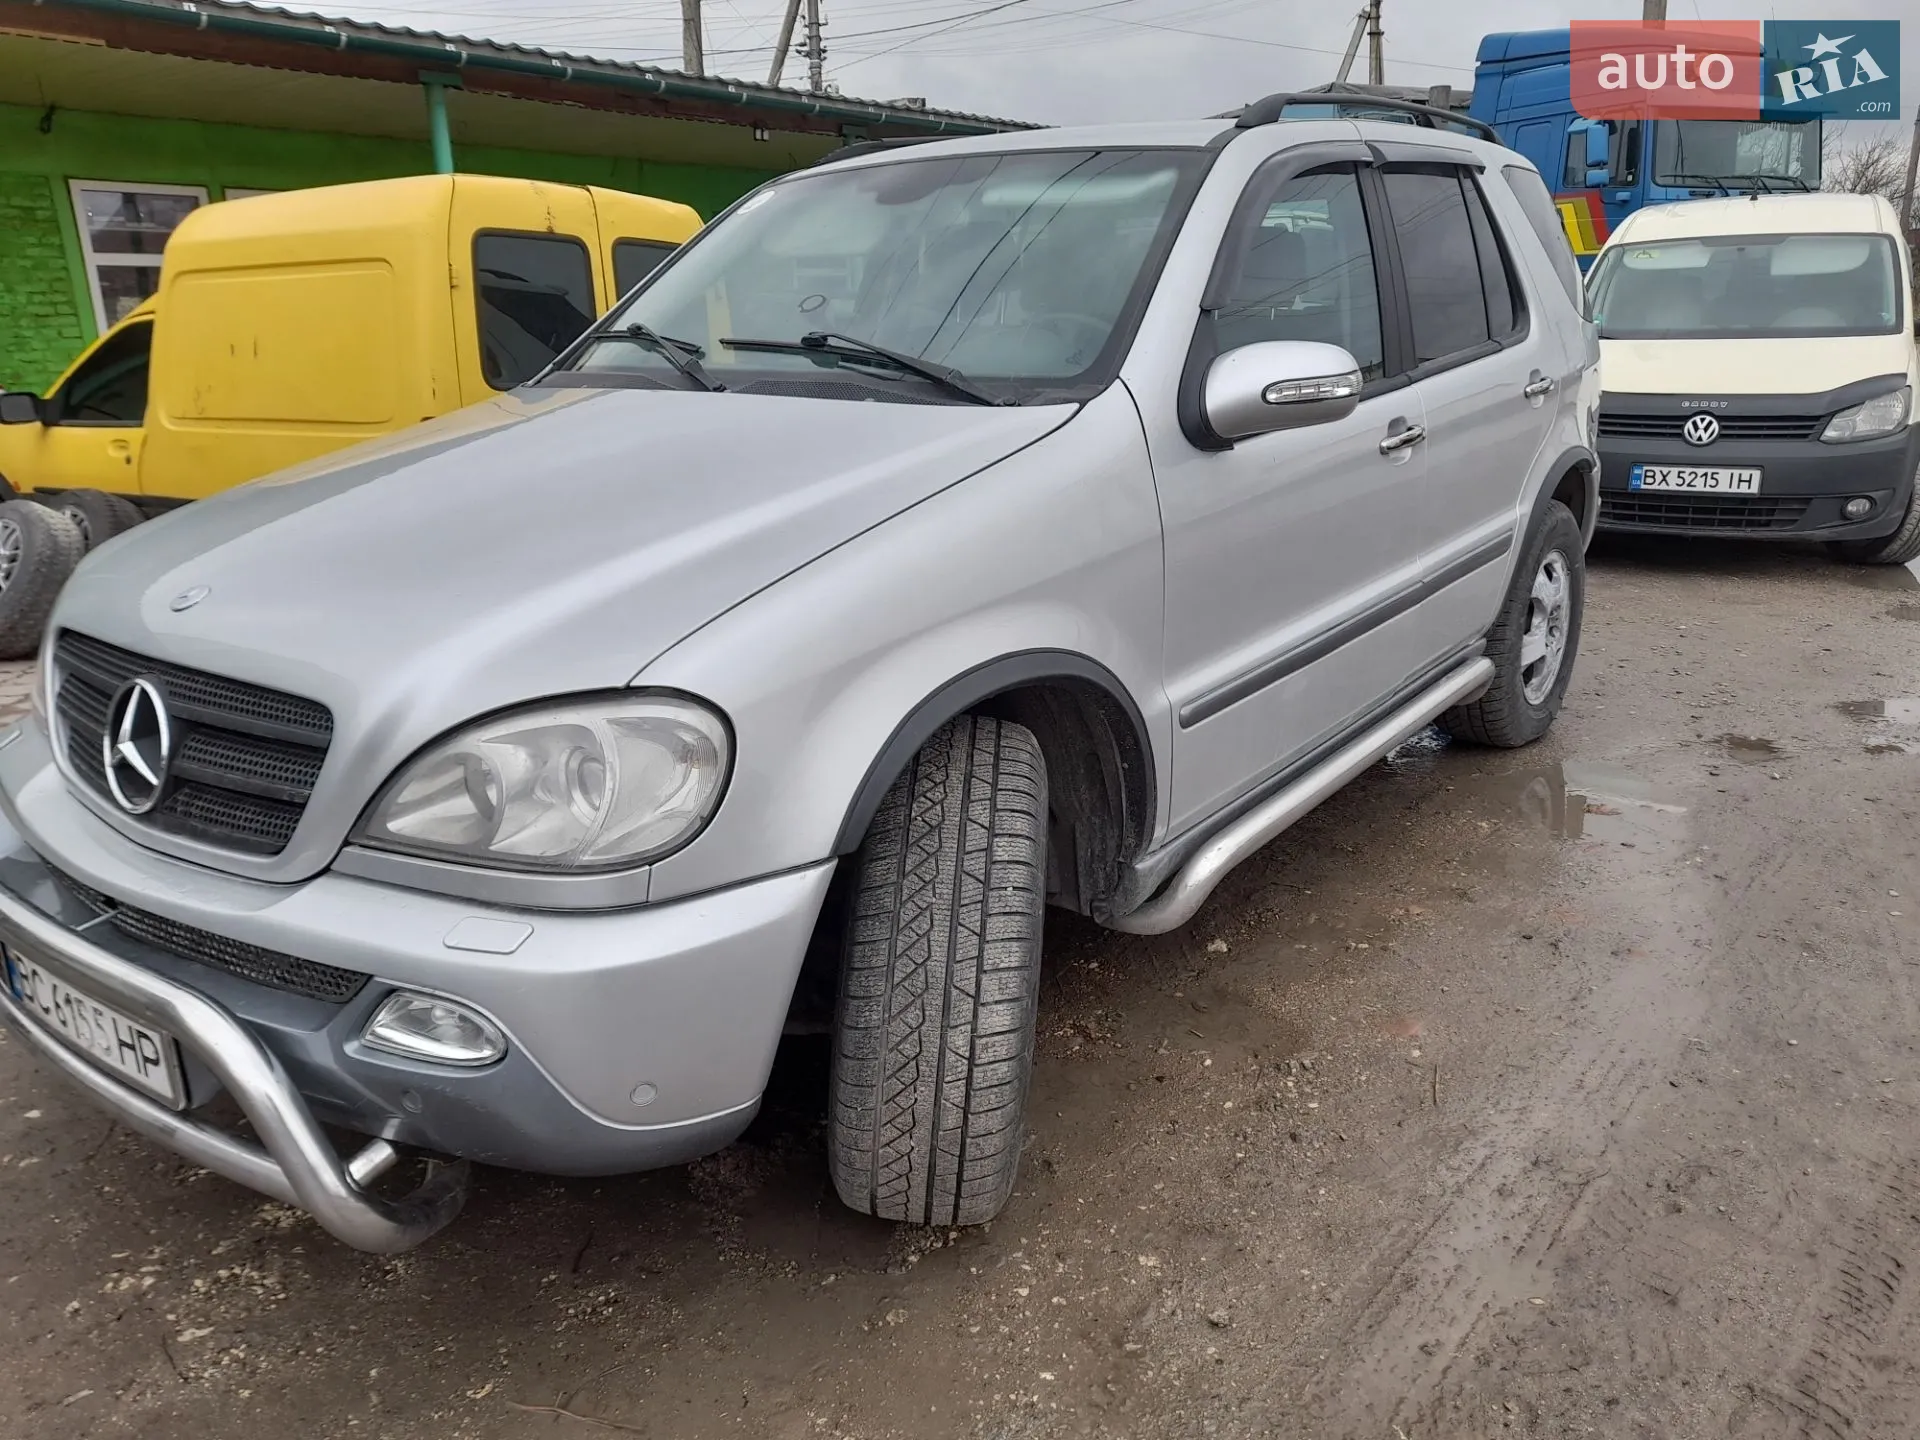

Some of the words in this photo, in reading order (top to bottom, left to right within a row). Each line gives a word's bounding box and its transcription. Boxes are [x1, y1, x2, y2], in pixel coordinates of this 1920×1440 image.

[1643, 469, 1671, 487] BX
[1676, 470, 1720, 489] 5215
[1729, 472, 1753, 490] IH
[111, 1016, 160, 1078] HP
